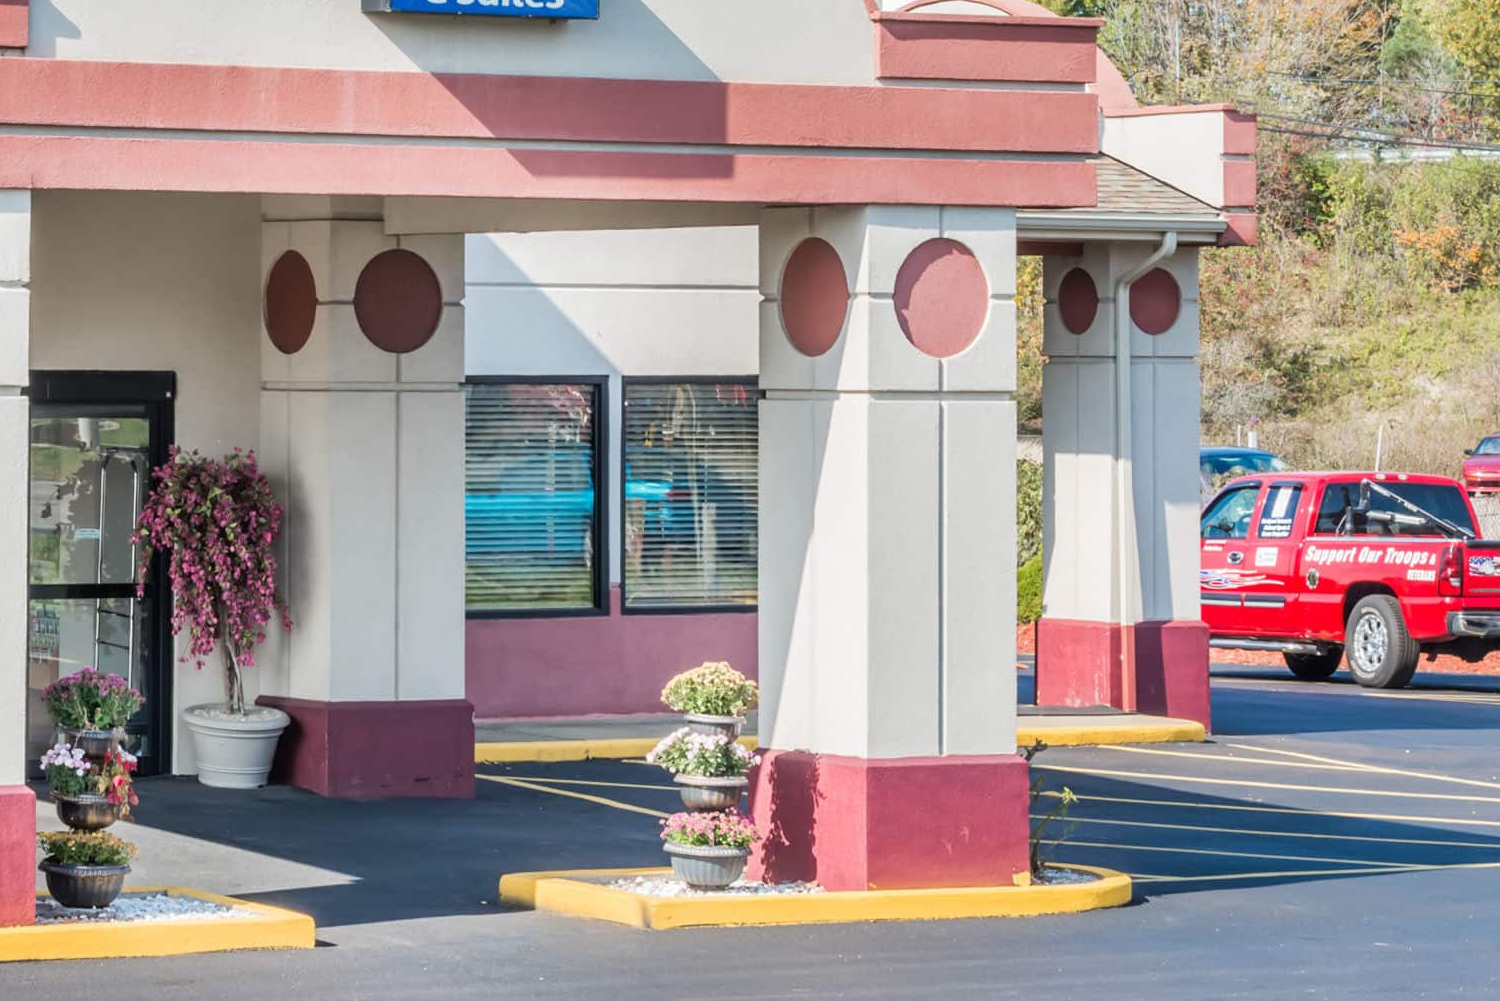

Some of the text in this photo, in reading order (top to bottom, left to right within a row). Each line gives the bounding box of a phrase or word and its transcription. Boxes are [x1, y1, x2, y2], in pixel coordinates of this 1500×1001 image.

[1305, 545, 1357, 566] Support
[1358, 546, 1383, 564] Our
[1384, 547, 1429, 568] Troops
